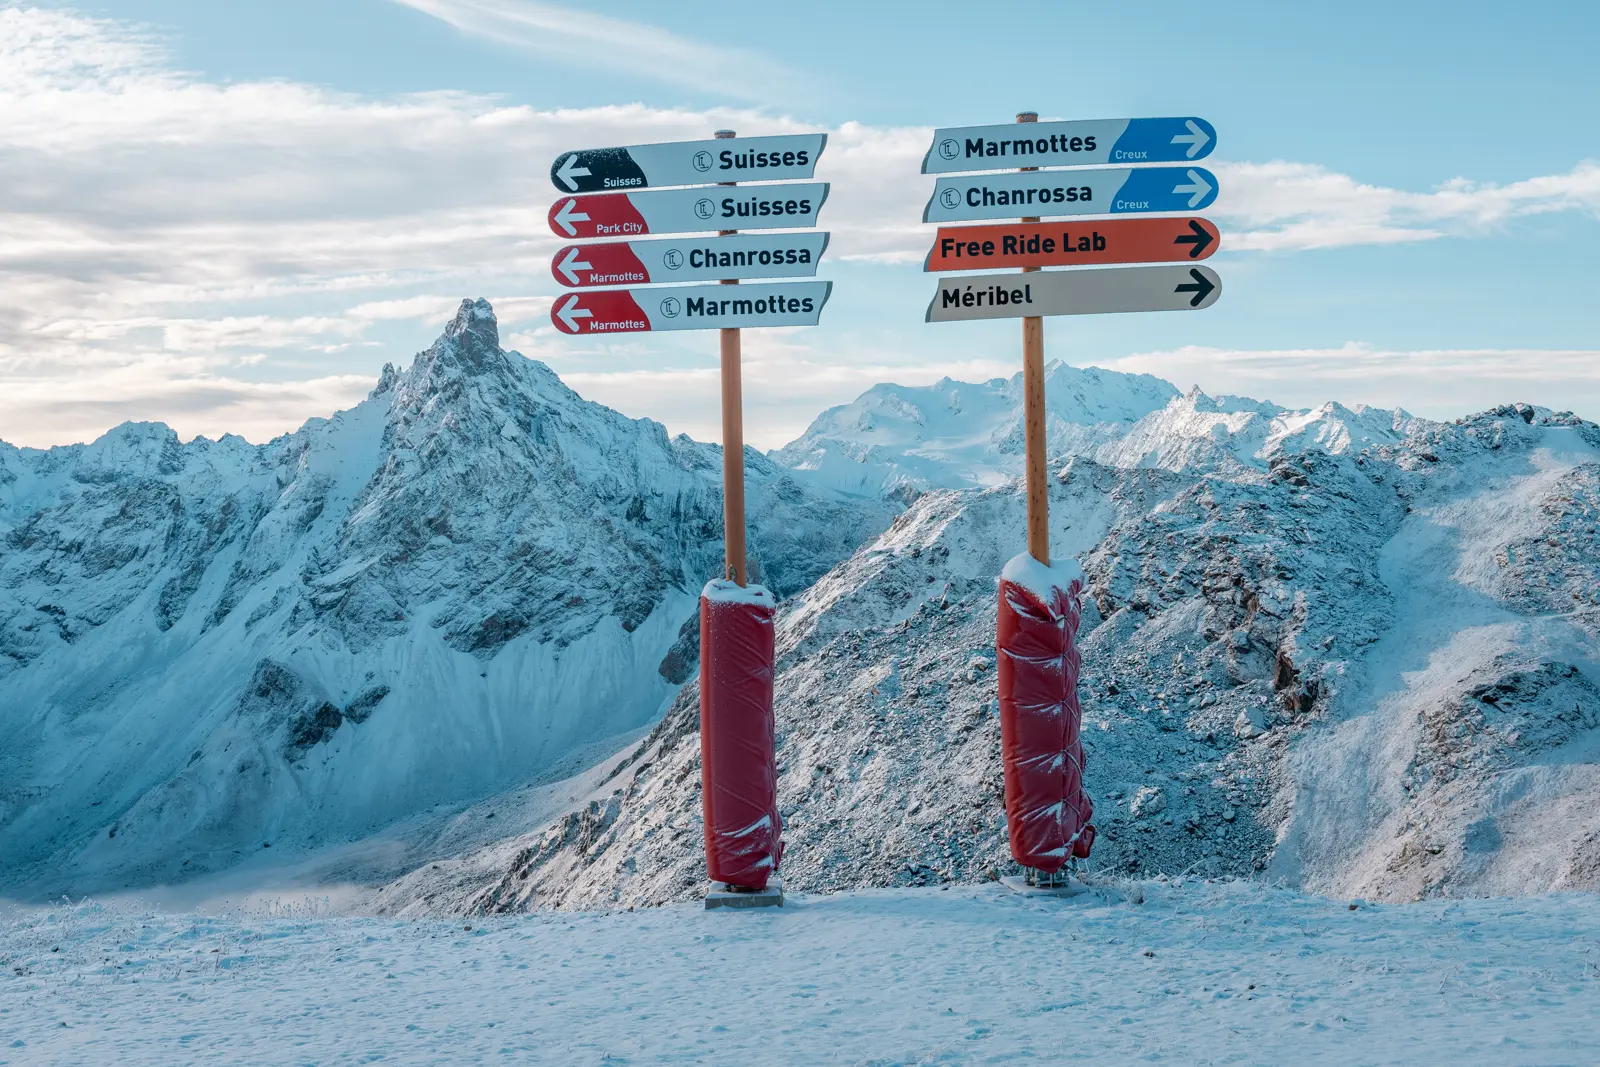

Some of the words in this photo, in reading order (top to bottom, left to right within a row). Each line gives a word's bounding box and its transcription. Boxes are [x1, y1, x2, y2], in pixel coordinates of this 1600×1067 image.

[965, 134, 1097, 158] Marmottes
[1115, 150, 1148, 160] Creux
[719, 149, 809, 170] Suisses
[603, 176, 642, 188] Suisses
[966, 185, 1093, 207] Chanrossa
[1116, 200, 1149, 210] Creux
[721, 197, 812, 218] Suisses
[596, 223, 621, 234] Park
[623, 222, 643, 234] City
[941, 237, 995, 258] Free
[1002, 234, 1056, 255] Ride
[1063, 232, 1106, 253] Lab
[689, 248, 811, 268] Chanrossa
[590, 271, 644, 283] Marmottes
[686, 296, 814, 317] Marmottes
[942, 284, 1033, 309] Méribel
[590, 319, 645, 331] Marmottes
